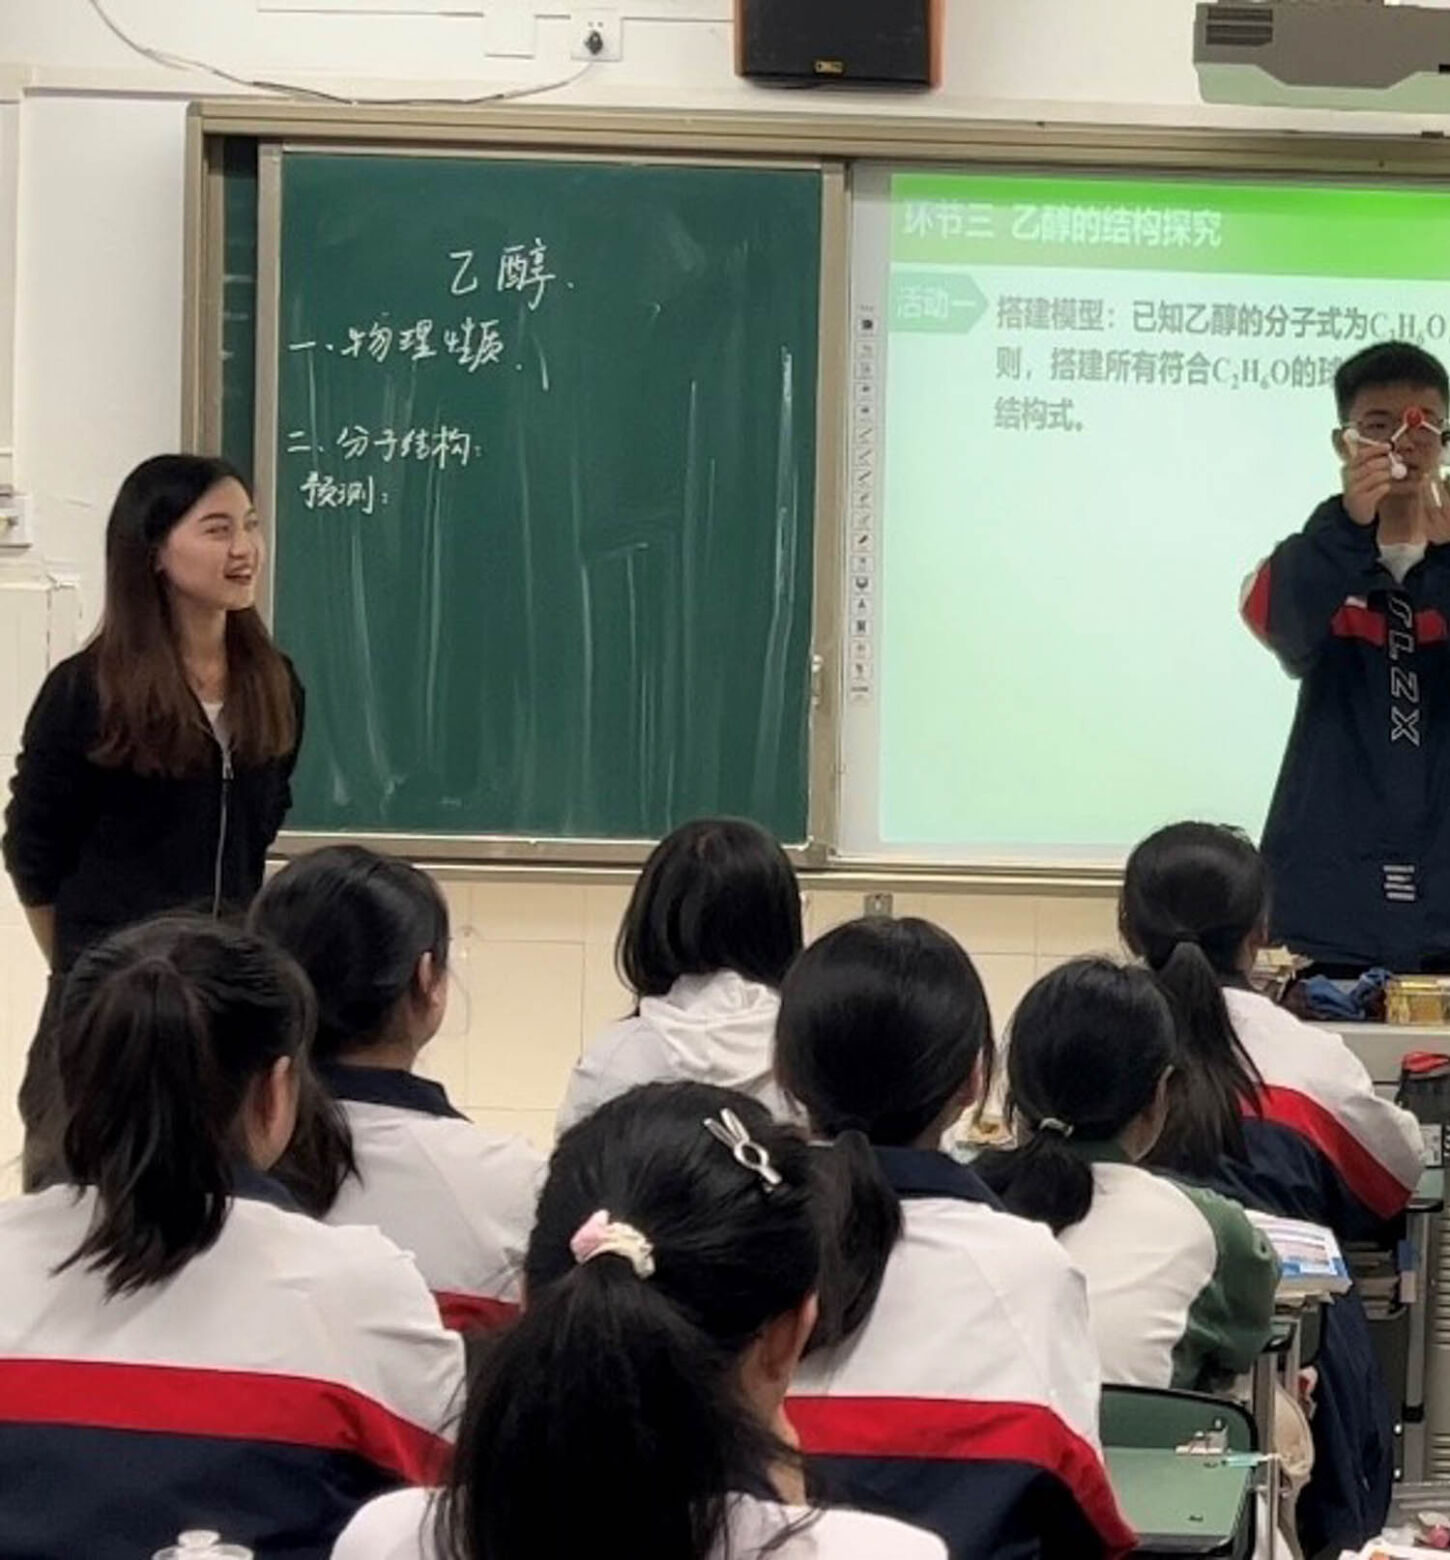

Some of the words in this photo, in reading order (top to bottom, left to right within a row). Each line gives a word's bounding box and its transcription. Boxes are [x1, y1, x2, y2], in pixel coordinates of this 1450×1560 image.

[904, 198, 995, 240] 环节三
[1011, 203, 1222, 248] 乙醇的结构探究
[897, 283, 977, 320] 活动一
